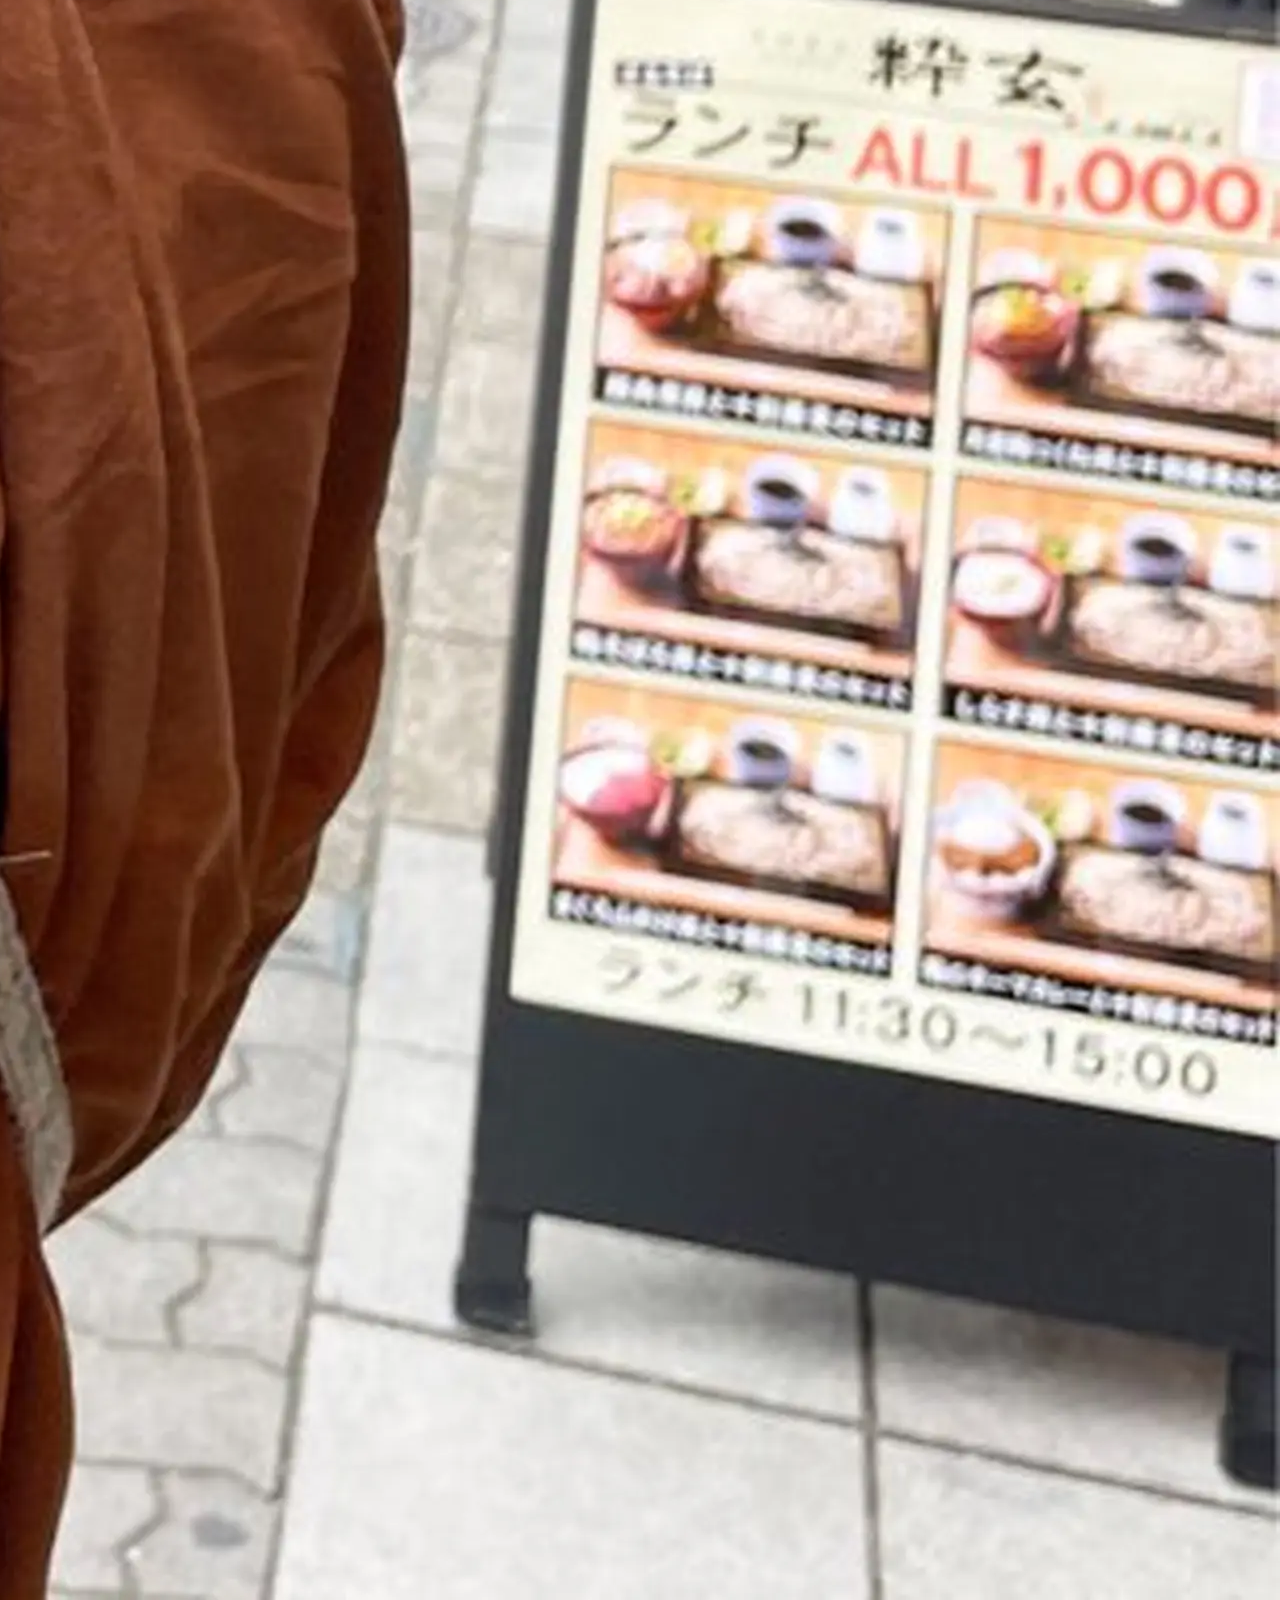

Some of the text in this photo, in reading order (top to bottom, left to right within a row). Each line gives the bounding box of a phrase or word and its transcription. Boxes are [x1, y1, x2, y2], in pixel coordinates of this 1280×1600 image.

[621, 92, 1280, 239] ランチ ALL 1,000
[594, 943, 768, 1013] ランチ
